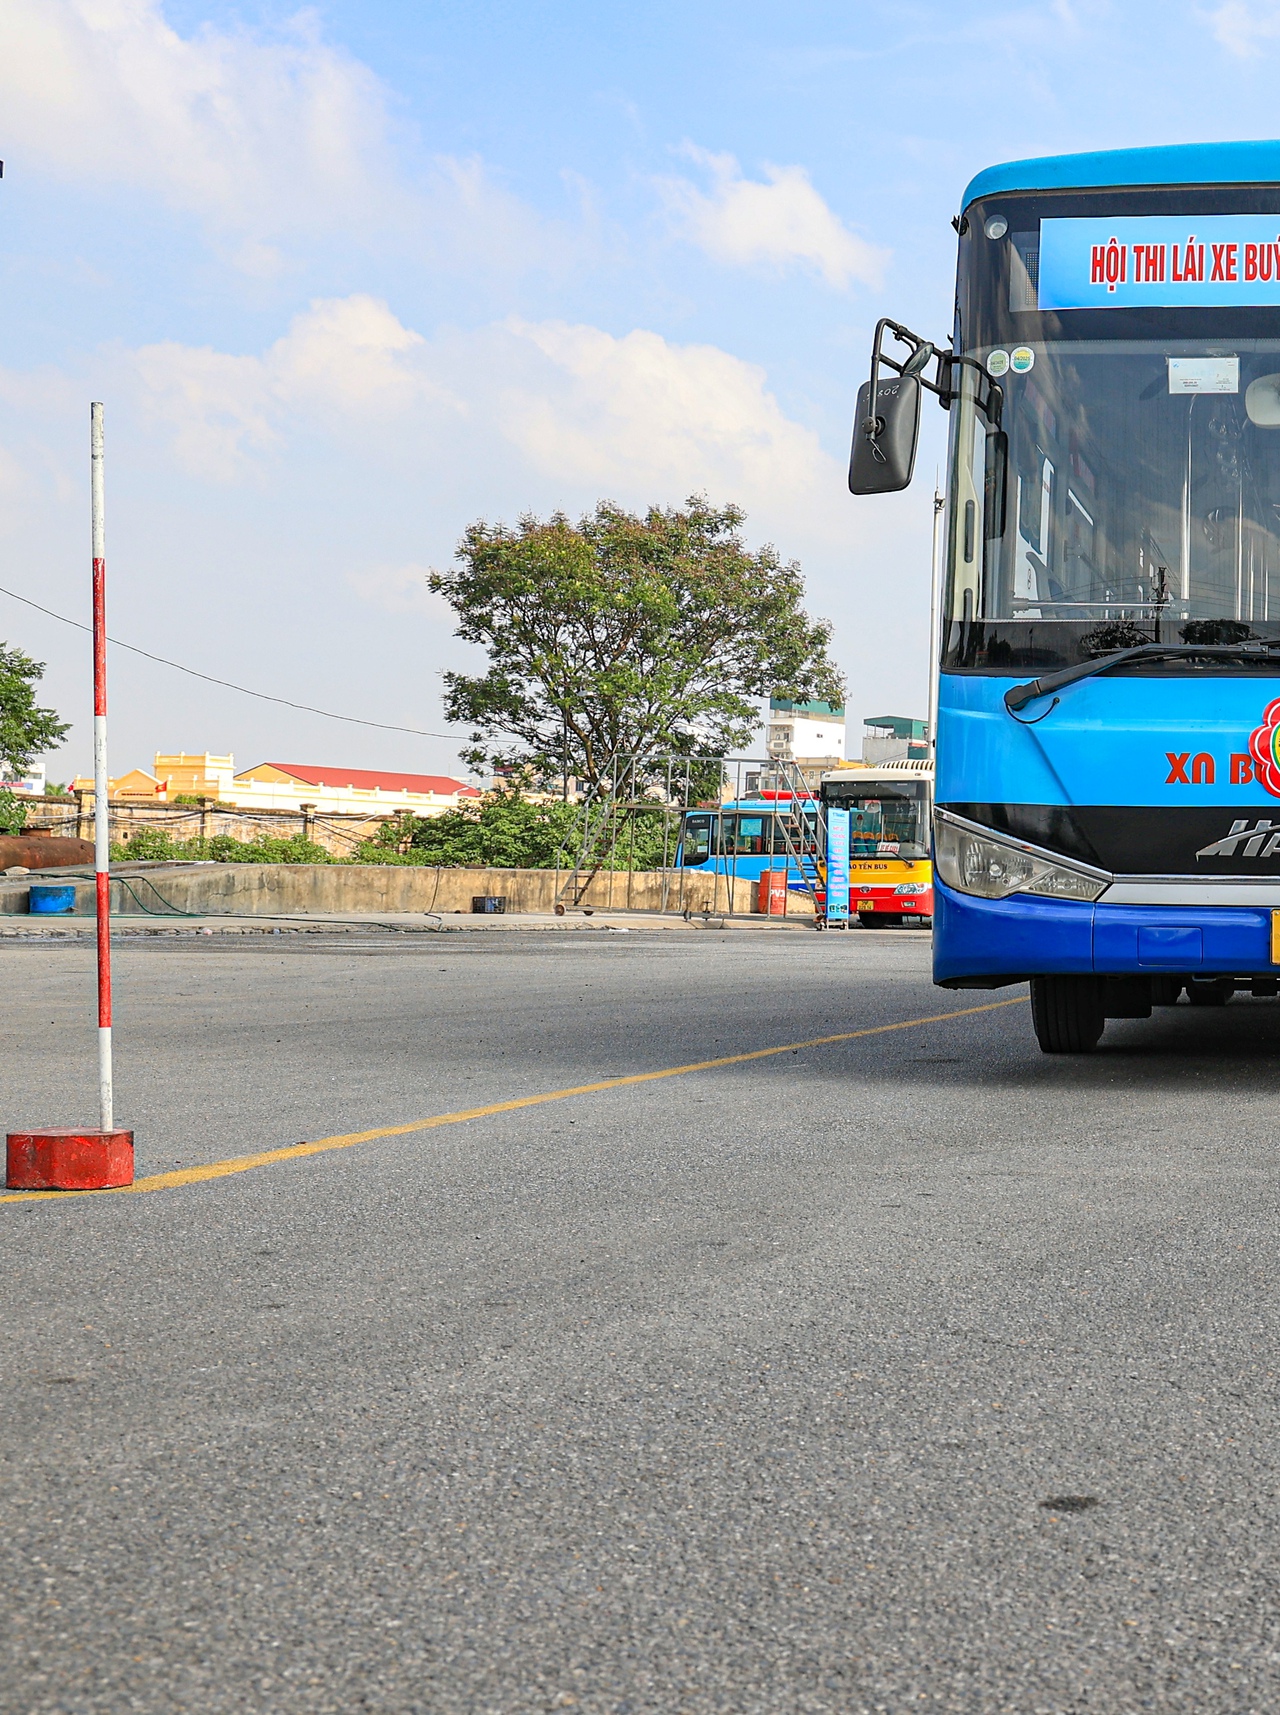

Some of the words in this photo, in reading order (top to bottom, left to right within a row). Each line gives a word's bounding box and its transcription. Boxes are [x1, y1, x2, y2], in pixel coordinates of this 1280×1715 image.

[1091, 237, 1126, 292] HỘI
[1132, 244, 1166, 283] THI
[1171, 236, 1204, 282] LÁI
[1209, 243, 1238, 282] XE
